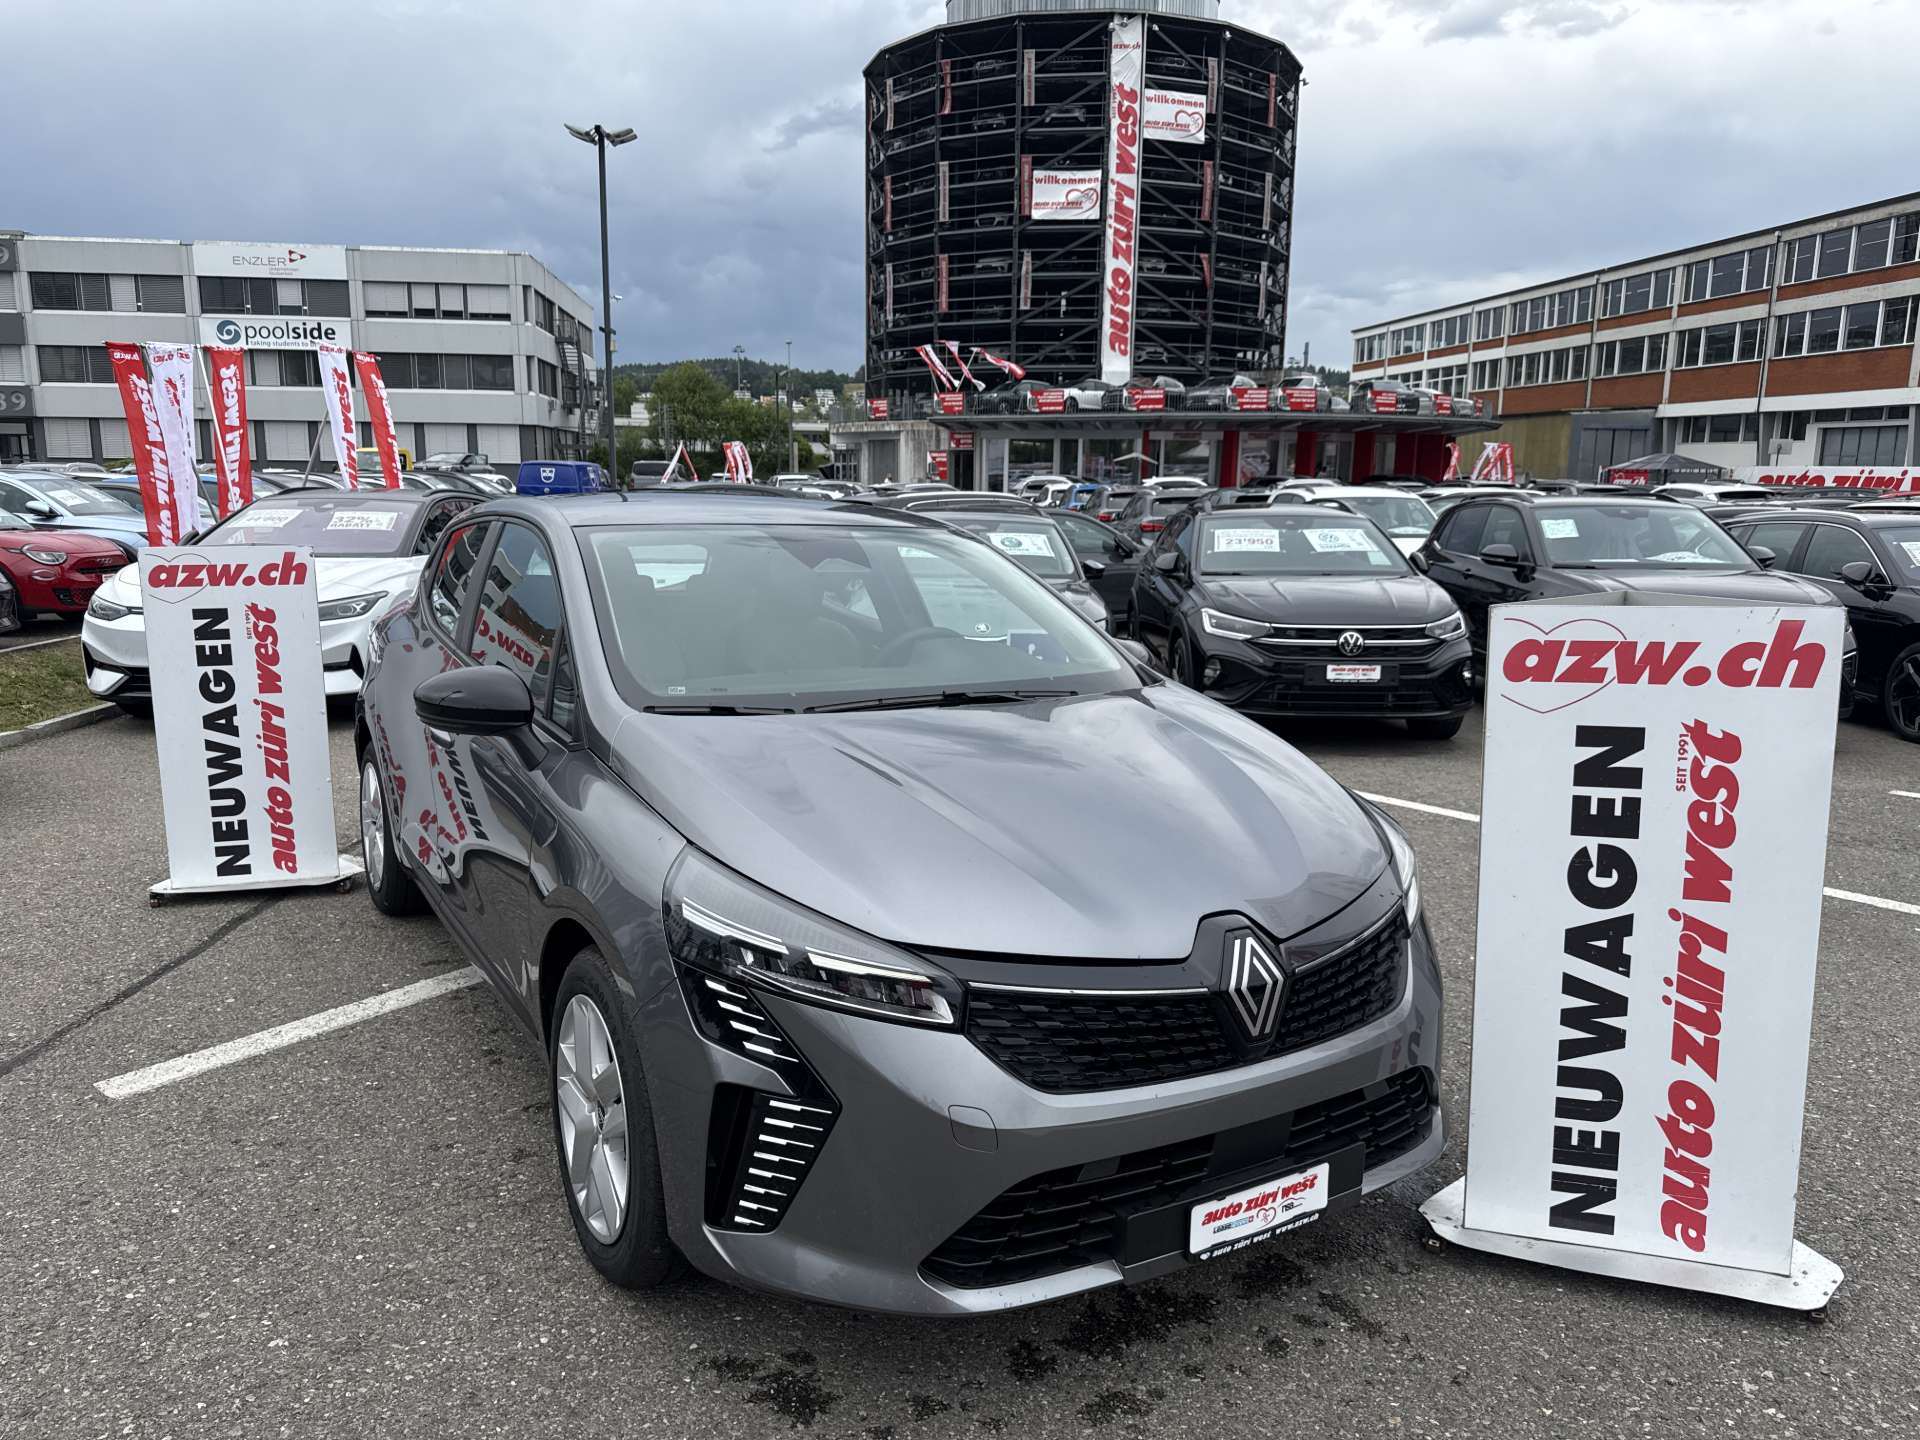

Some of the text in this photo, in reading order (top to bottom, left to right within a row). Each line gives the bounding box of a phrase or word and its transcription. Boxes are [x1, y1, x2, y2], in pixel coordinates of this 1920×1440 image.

[1145, 94, 1204, 108] willkommen
[1034, 174, 1099, 185] willkommen
[1106, 82, 1139, 356] auto züri west
[232, 255, 287, 267] ENZLER
[244, 321, 336, 346] poolside
[148, 551, 308, 588] azw.ch
[1503, 619, 1826, 690] azw.ch
[191, 607, 253, 878] NEUWAGEN
[245, 602, 298, 875] auto züri west
[1675, 733, 1690, 792] SEIT 1991
[1548, 724, 1646, 1236] NEUWAGEN
[1654, 718, 1743, 1253] auto züri west
[1201, 1200, 1243, 1226] auto
[1243, 1186, 1281, 1214] züri
[1281, 1173, 1318, 1200] west
[1212, 1244, 1232, 1257] auto
